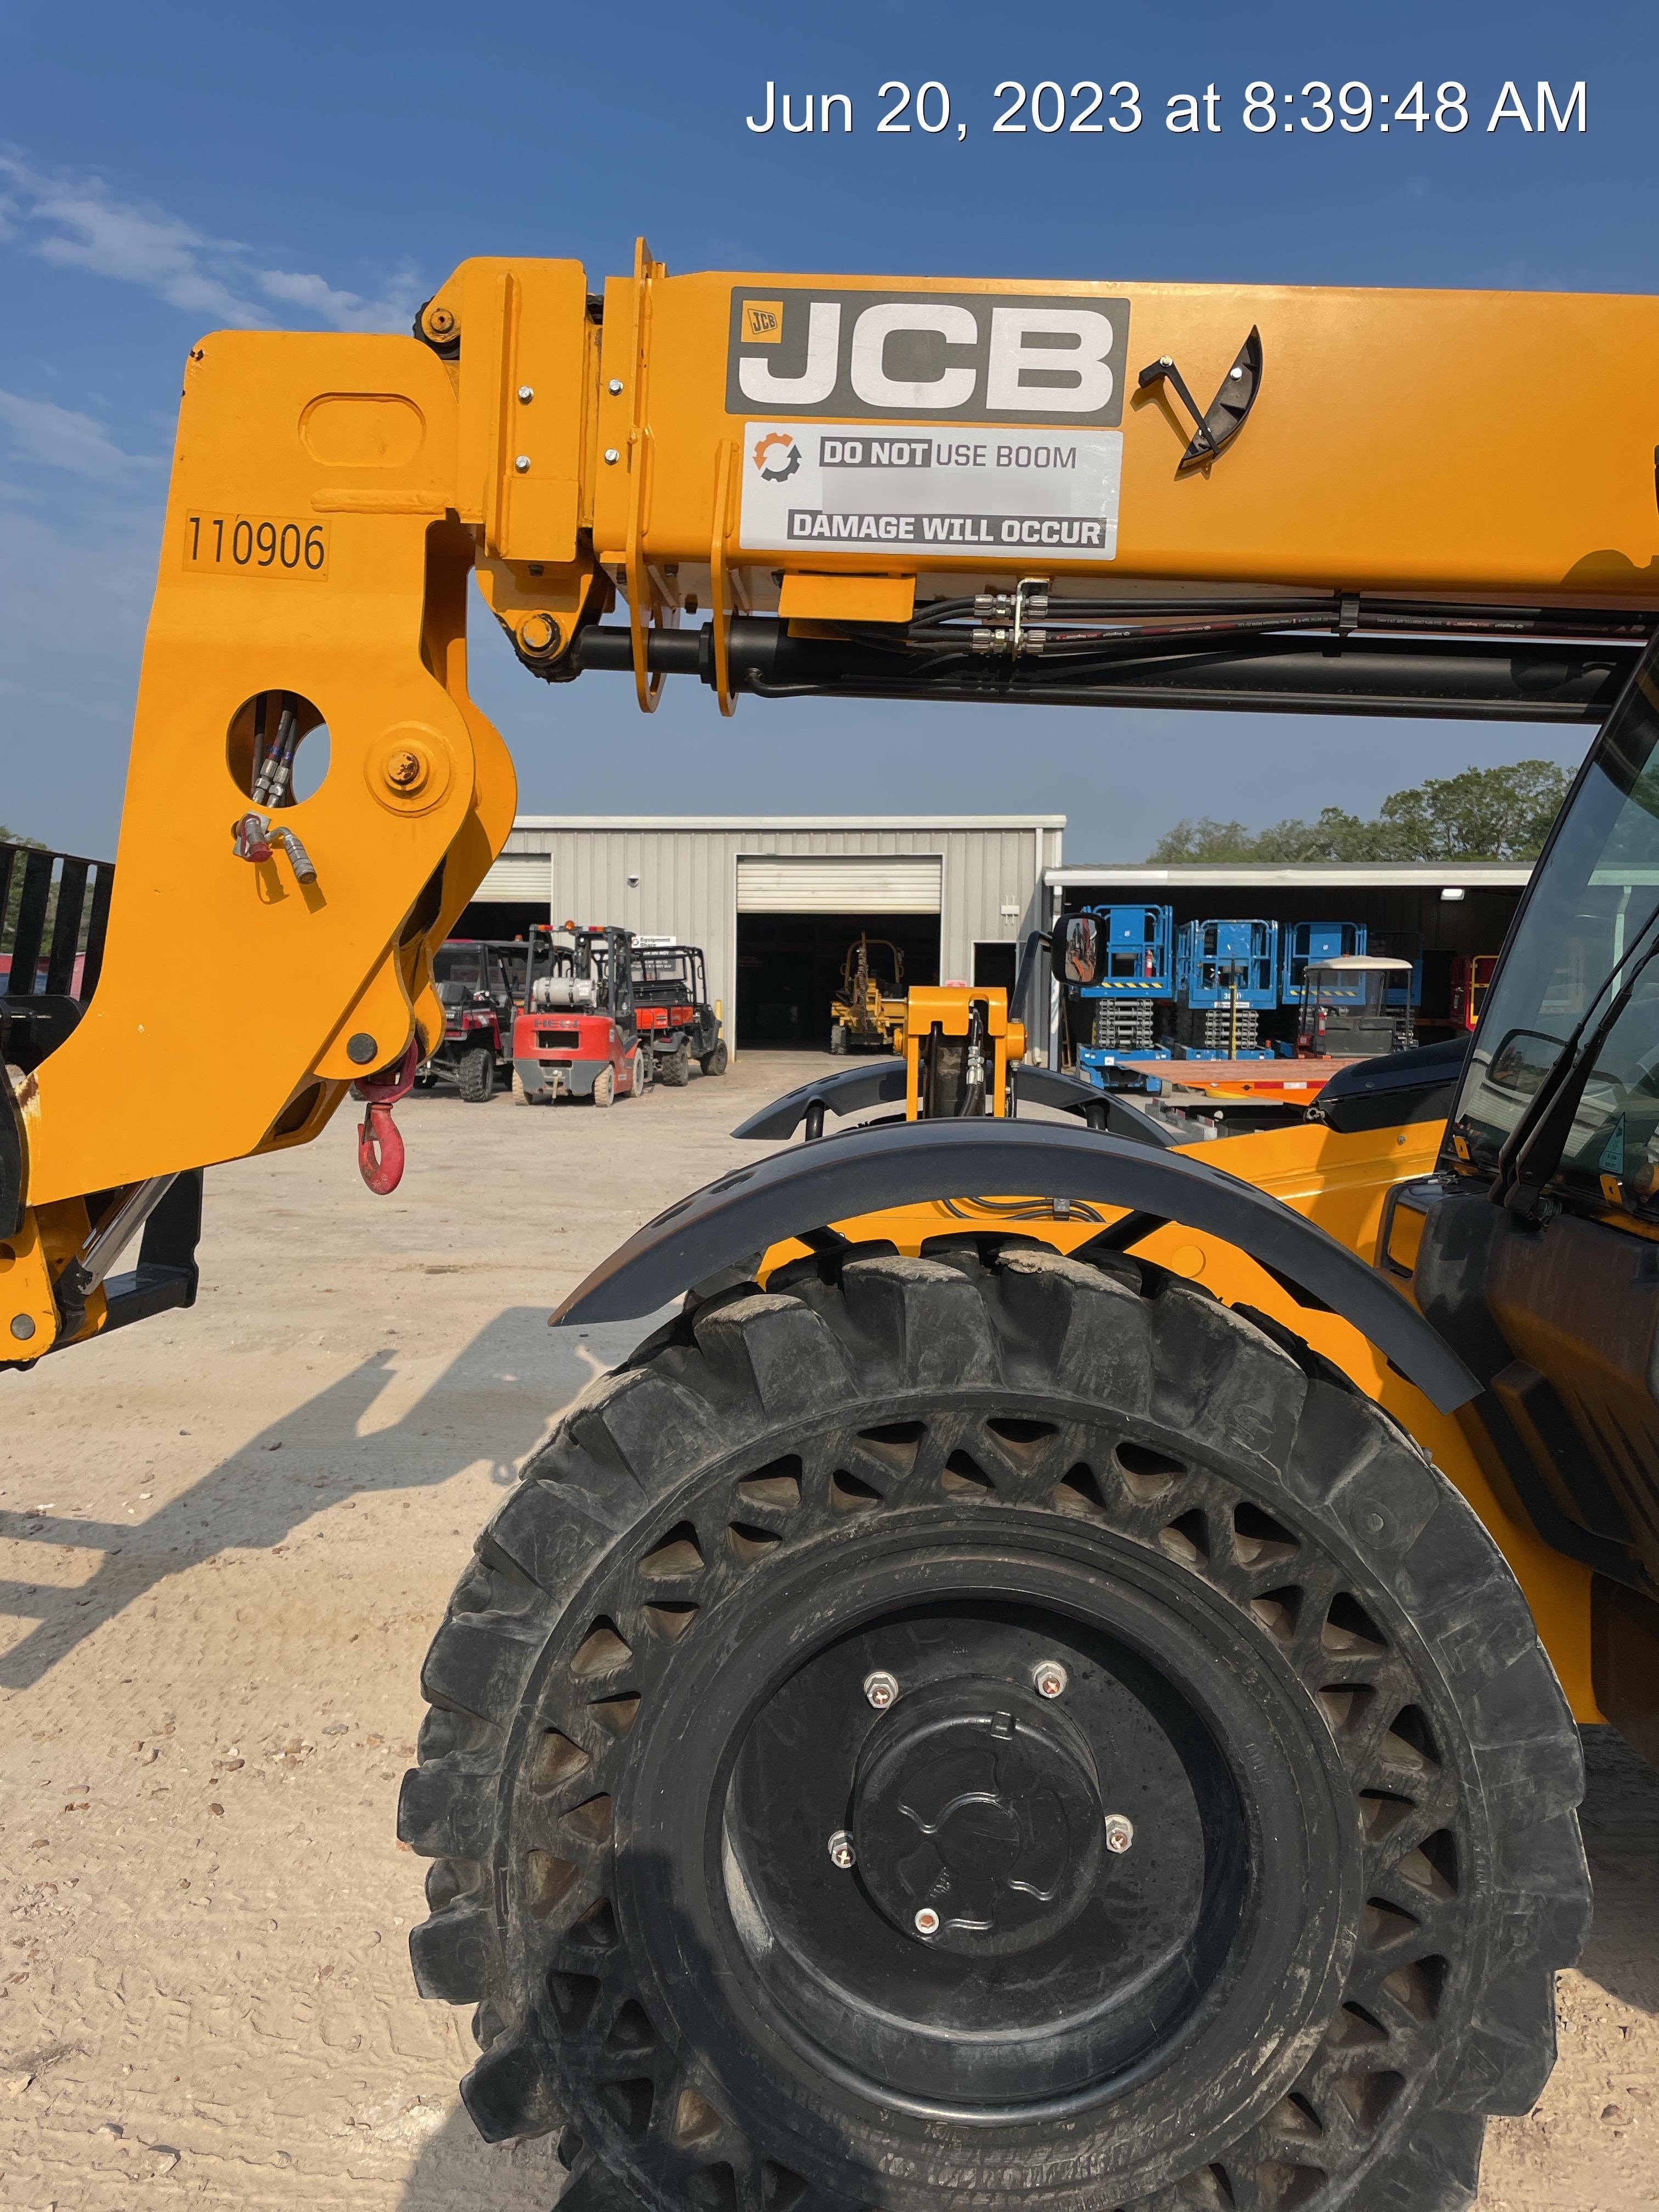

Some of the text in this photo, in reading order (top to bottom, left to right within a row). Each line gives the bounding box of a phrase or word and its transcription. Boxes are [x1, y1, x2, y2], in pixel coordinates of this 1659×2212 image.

[753, 312, 775, 331] JCB
[739, 302, 1114, 412] JCB
[823, 441, 1077, 469] DO NOT USE BOOM
[190, 517, 324, 569] 110906
[792, 514, 1101, 545] DAMAGE WILL OCCUR
